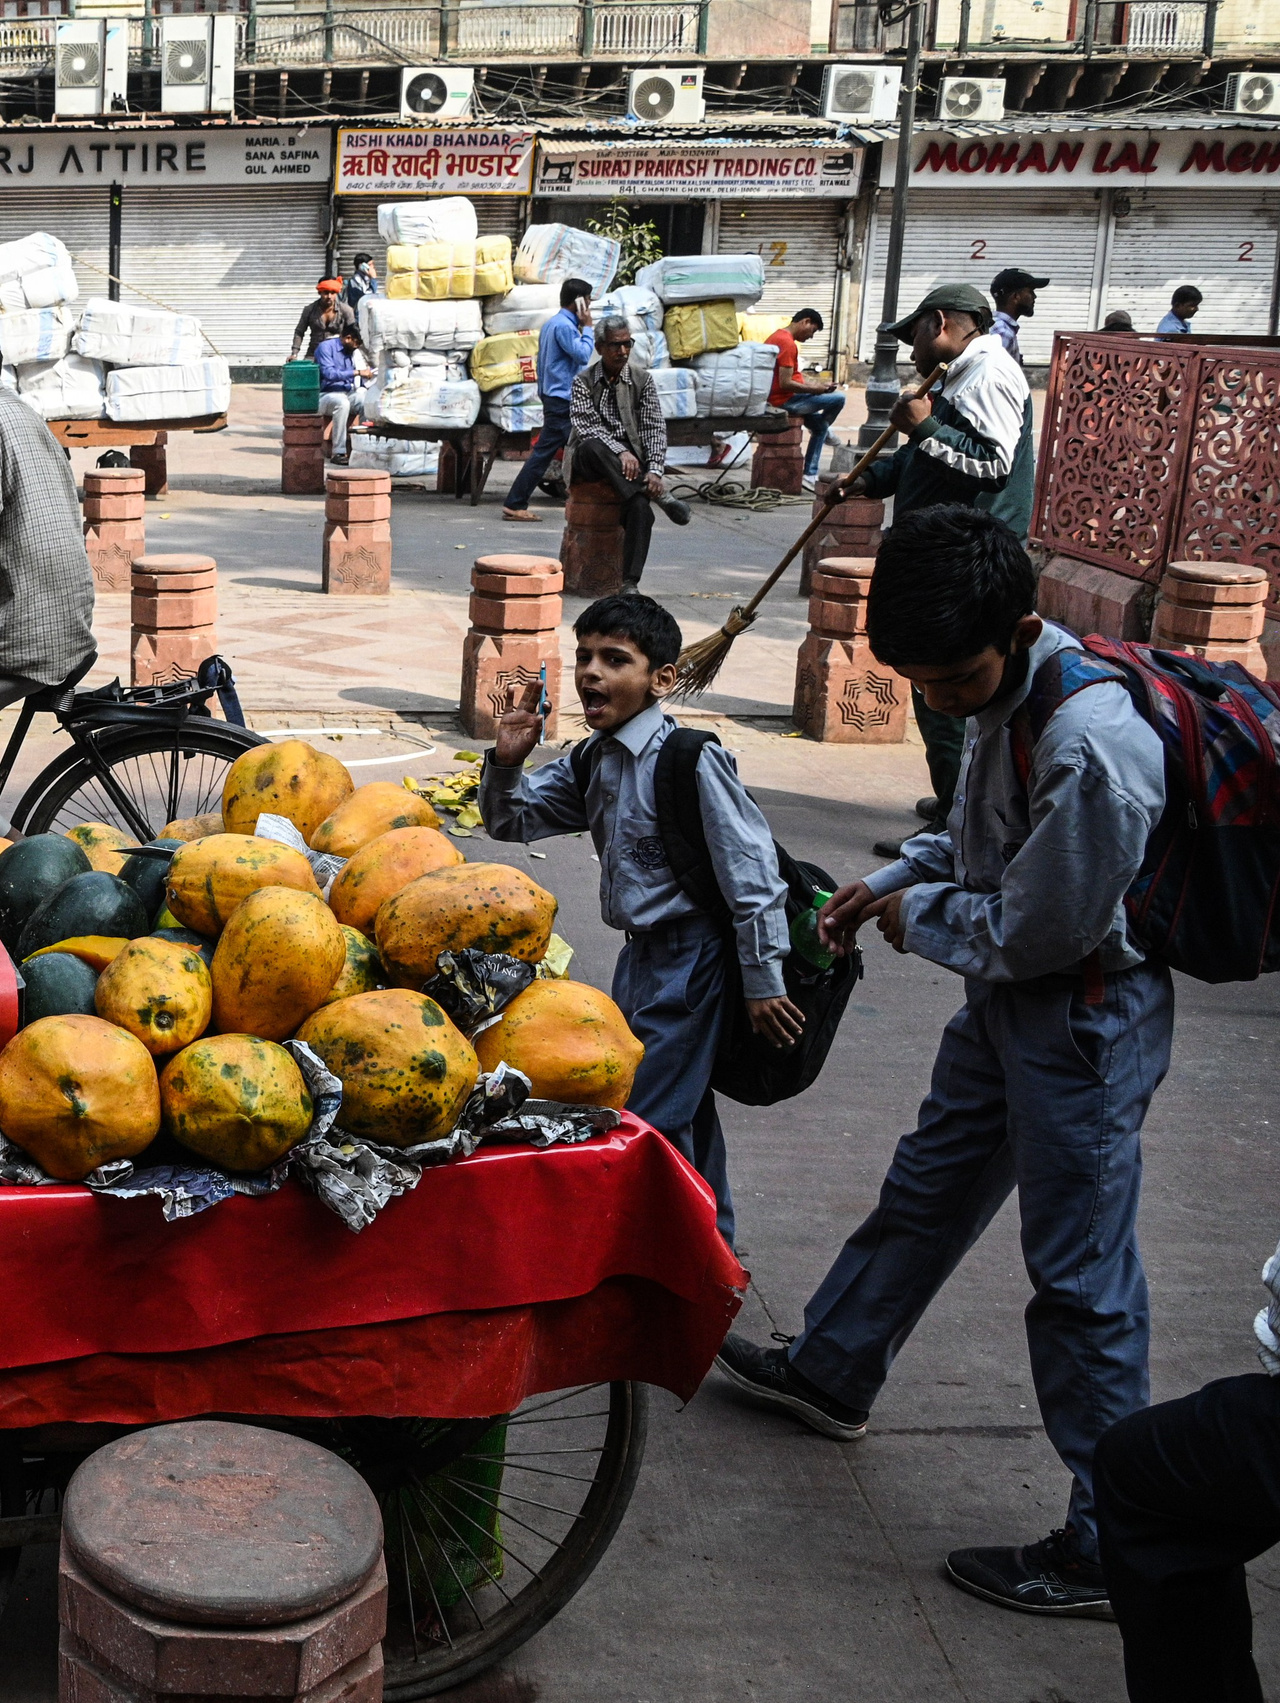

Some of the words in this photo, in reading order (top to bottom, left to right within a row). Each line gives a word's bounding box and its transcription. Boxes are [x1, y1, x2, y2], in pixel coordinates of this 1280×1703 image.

[245, 138, 279, 147] MARIA
[288, 137, 296, 146] B
[346, 134, 382, 147] RISHI
[386, 134, 429, 147] KHADI
[433, 133, 511, 147] BHANDAR
[59, 143, 206, 173] ATTIRE
[245, 152, 274, 161] SANA
[279, 151, 320, 160] SAFINA
[343, 149, 390, 177] ऋषि
[392, 148, 442, 180] खादी
[446, 153, 522, 177] भण्डार
[914, 141, 1084, 173] MOHAN
[1091, 141, 1161, 173] LAL
[245, 165, 267, 174] GUL
[272, 165, 310, 174] AHMED
[578, 160, 632, 178] SURAJ
[634, 159, 708, 178] PRAKASH
[713, 158, 793, 177] TRADING
[794, 158, 818, 176] CO.
[769, 241, 787, 266] 2
[970, 239, 986, 260] 2
[1237, 241, 1254, 261] 2
